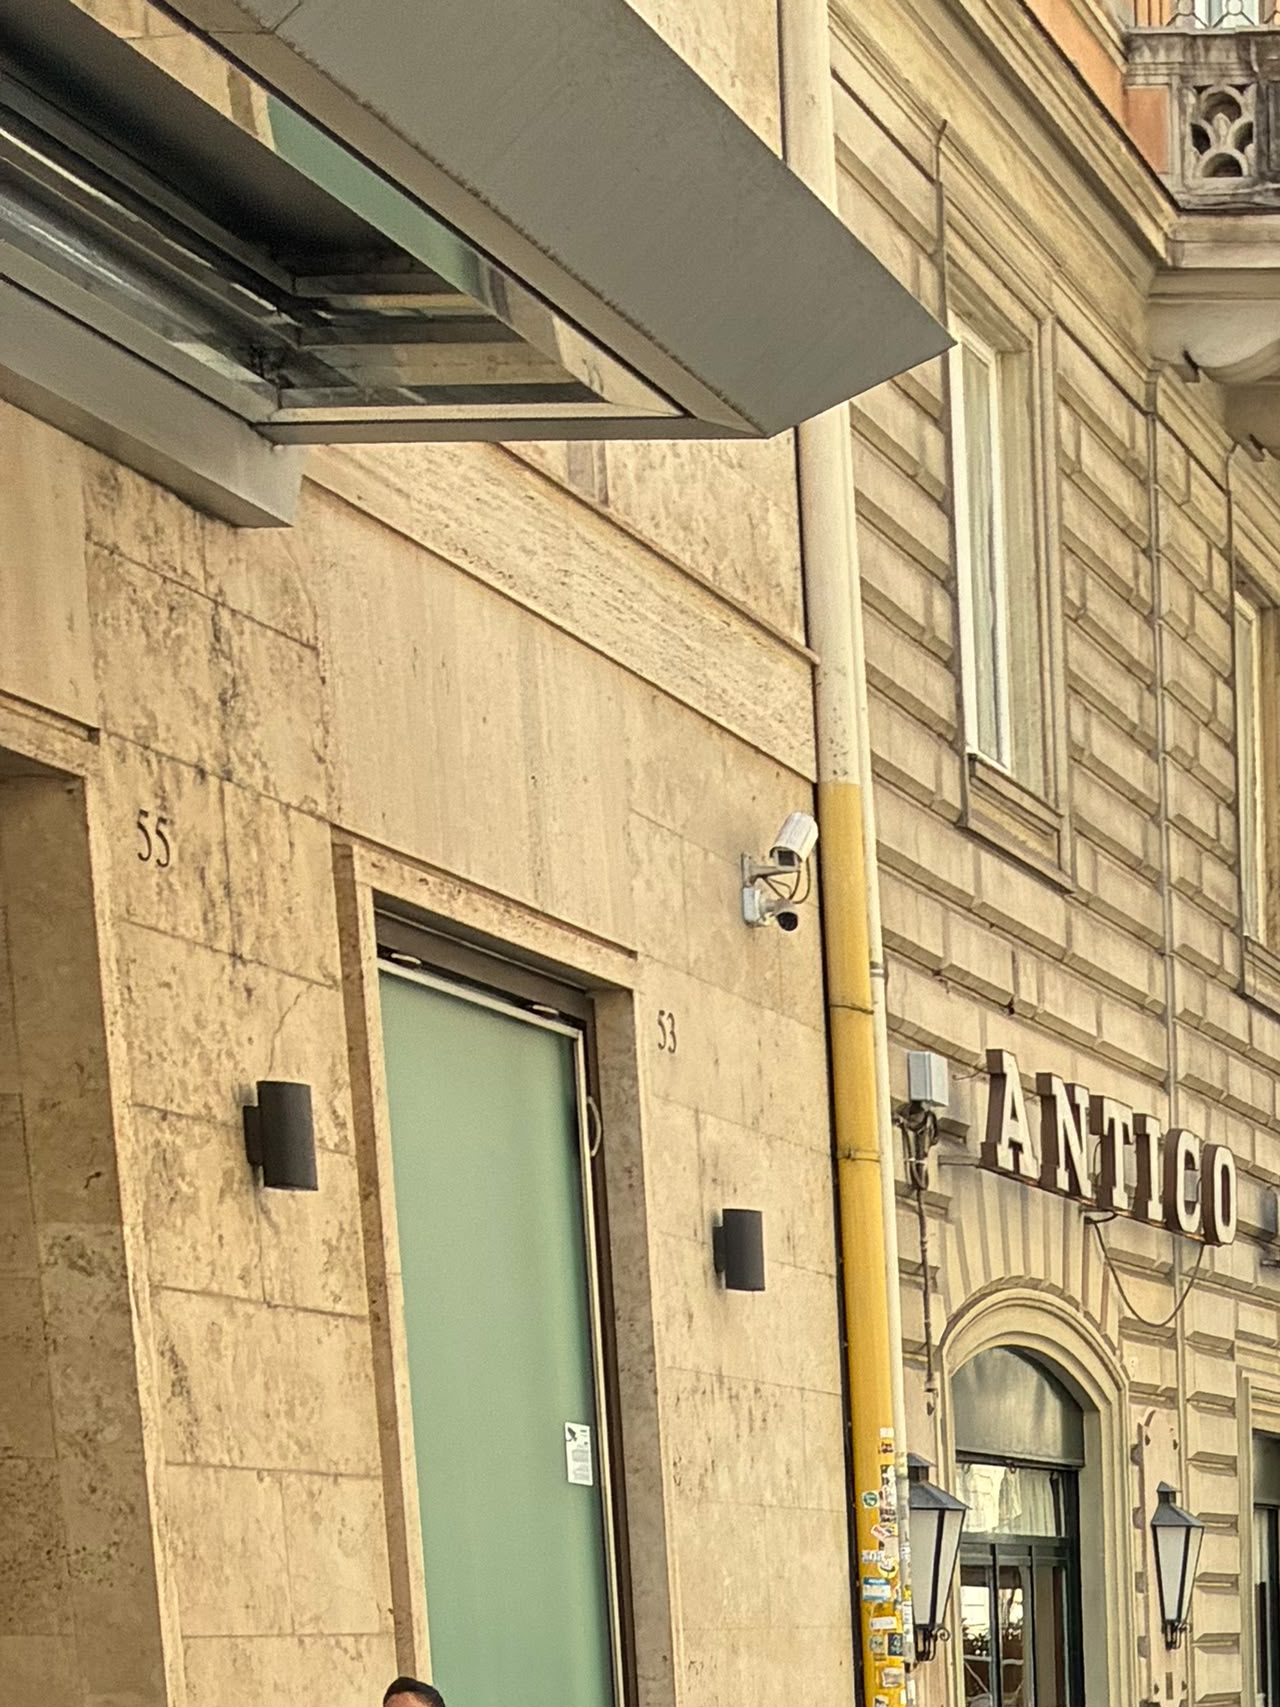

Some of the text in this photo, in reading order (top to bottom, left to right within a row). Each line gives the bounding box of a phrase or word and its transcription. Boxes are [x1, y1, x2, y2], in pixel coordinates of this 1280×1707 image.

[136, 808, 171, 868] 55
[657, 1009, 677, 1054] 53
[982, 1048, 1238, 1246] ANTICO
